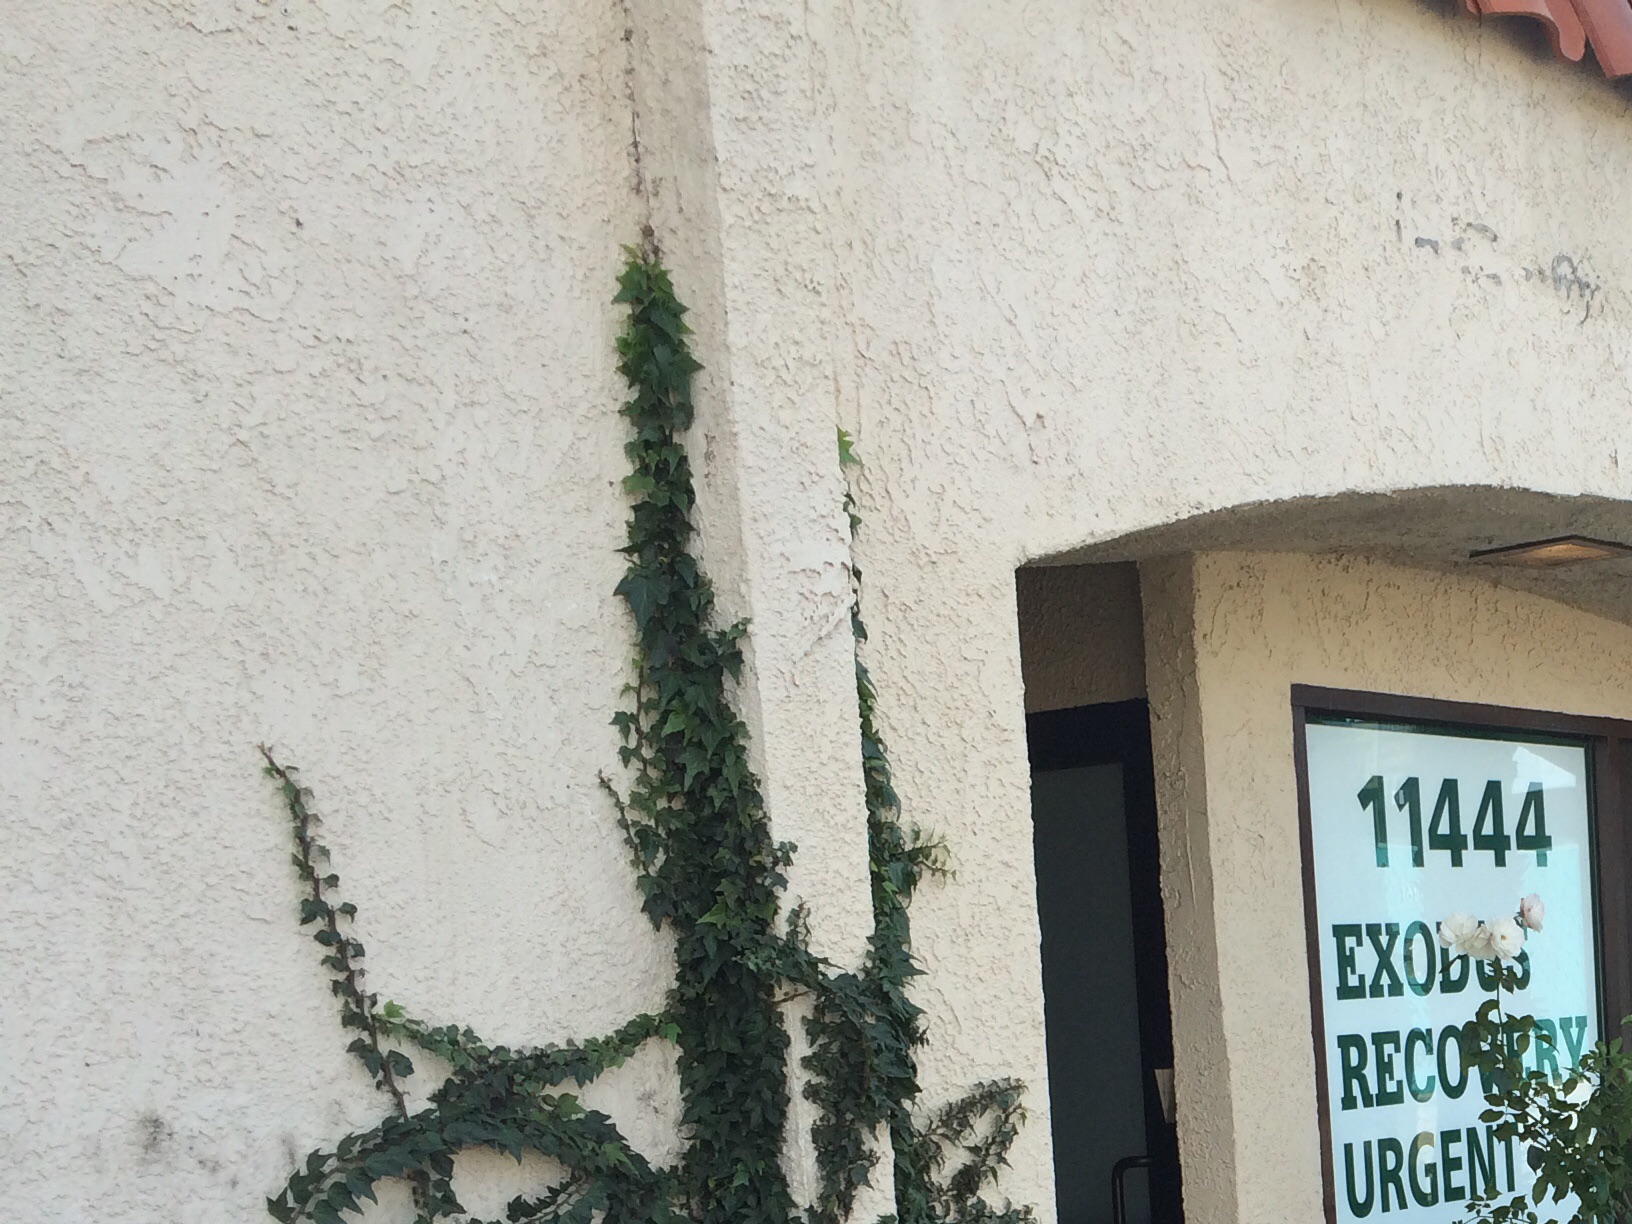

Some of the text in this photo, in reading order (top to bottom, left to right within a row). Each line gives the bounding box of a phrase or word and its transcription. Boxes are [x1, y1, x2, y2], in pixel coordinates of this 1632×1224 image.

[1356, 775, 1553, 868] 11444
[1337, 1015, 1588, 1111] RECORY
[1343, 1122, 1519, 1219] URGENT
